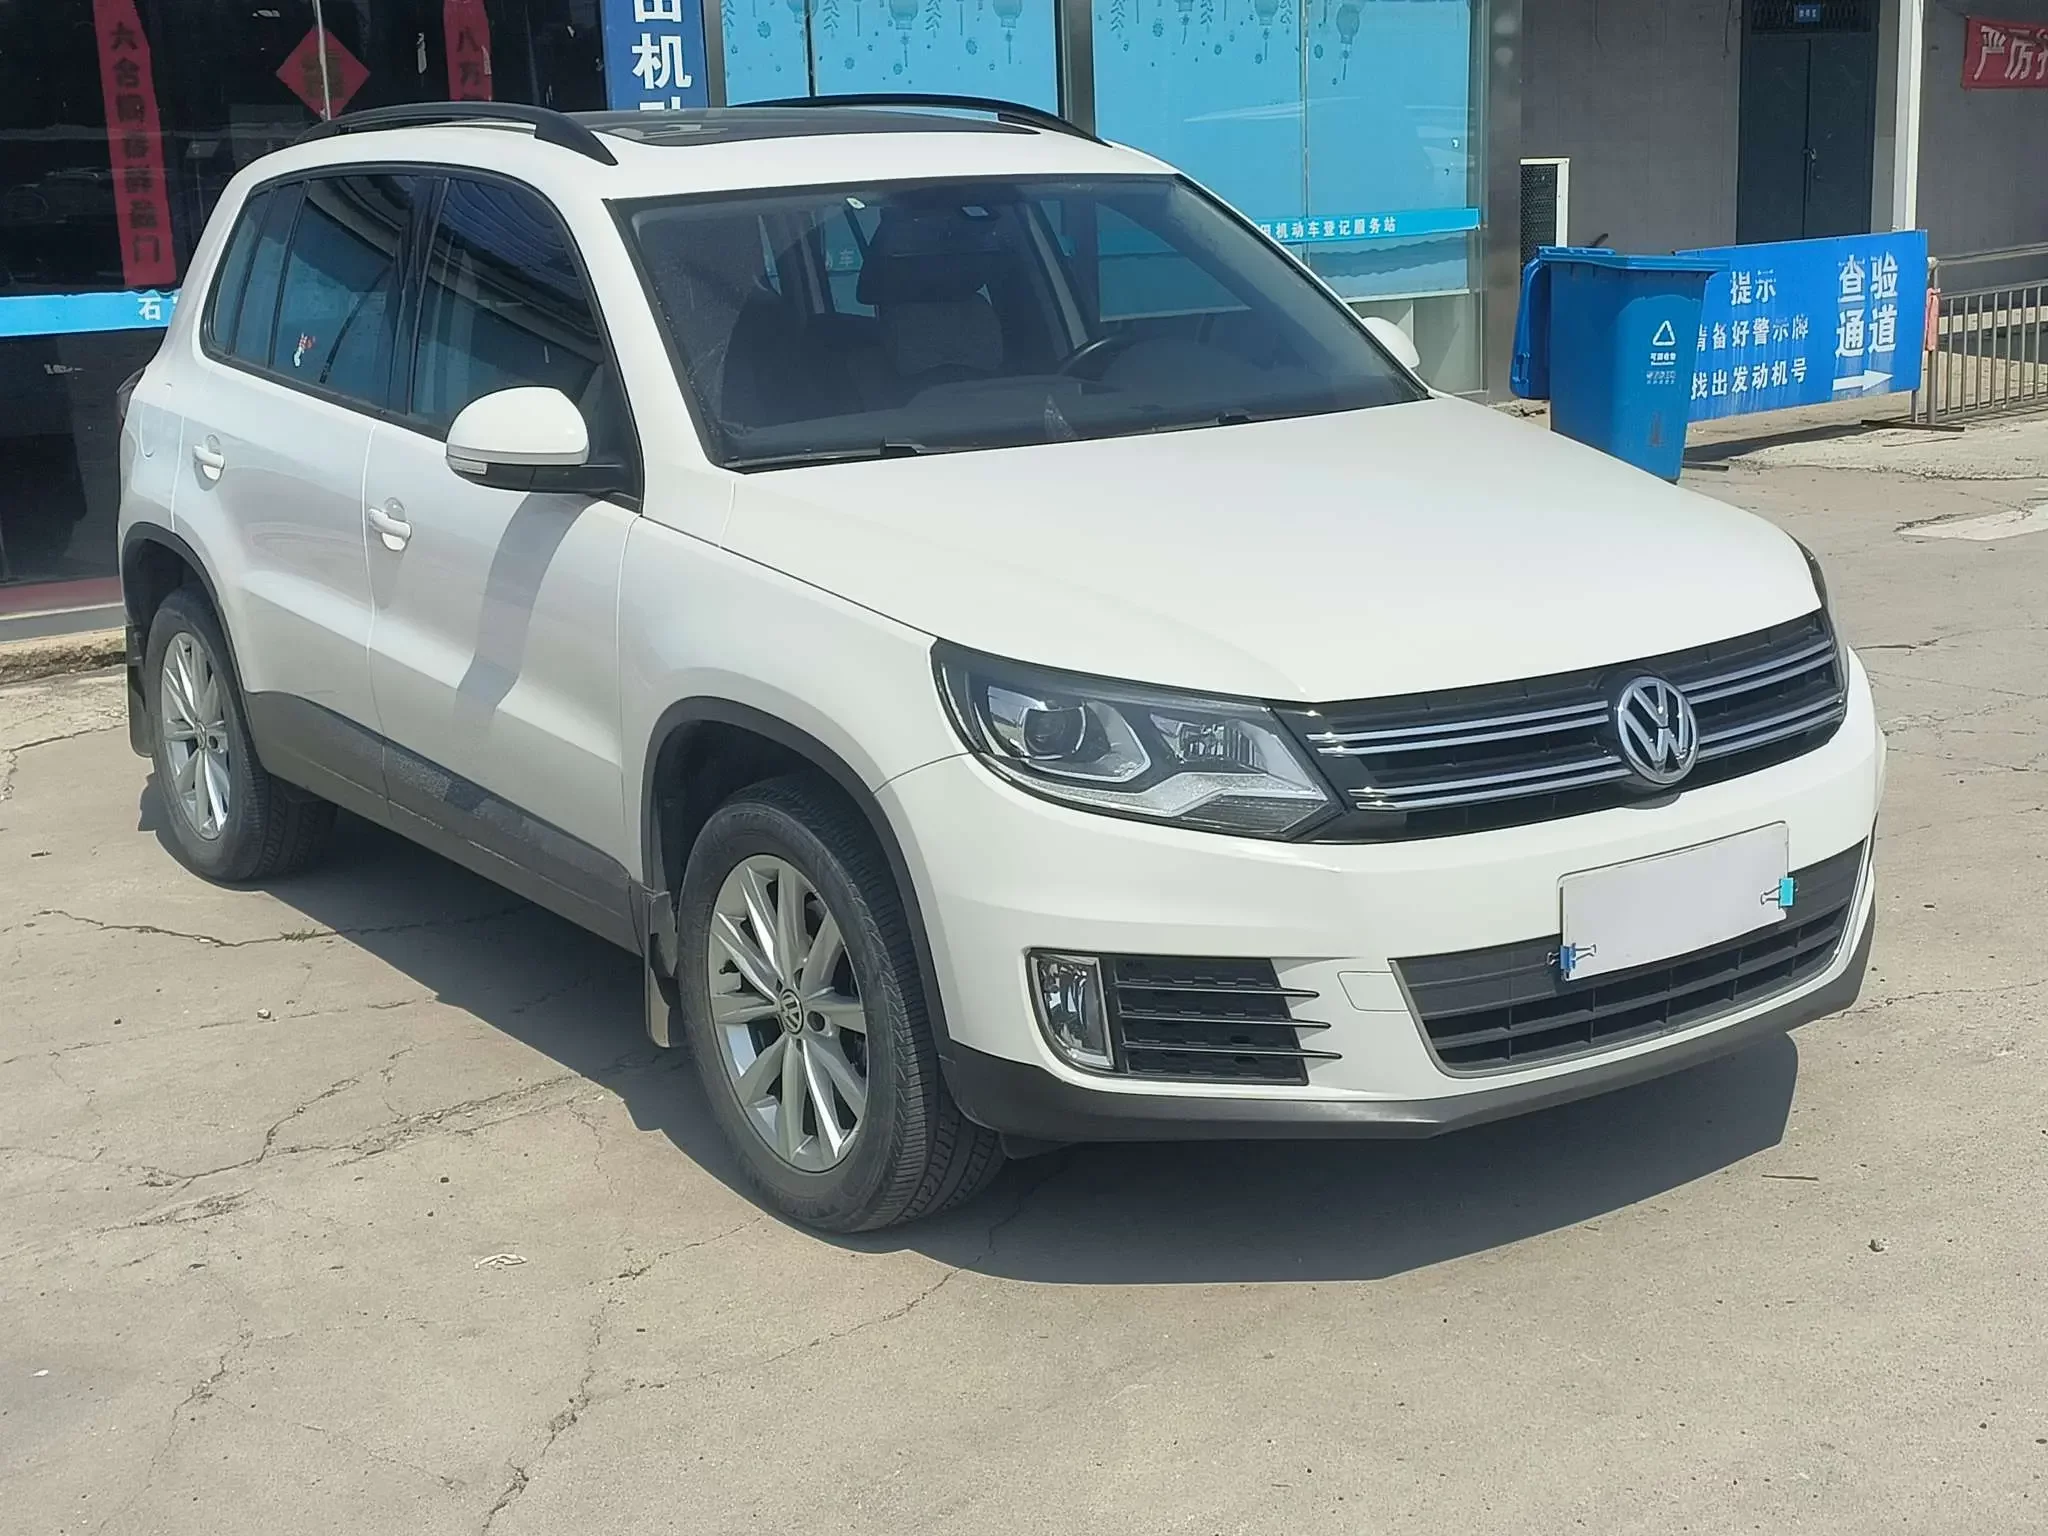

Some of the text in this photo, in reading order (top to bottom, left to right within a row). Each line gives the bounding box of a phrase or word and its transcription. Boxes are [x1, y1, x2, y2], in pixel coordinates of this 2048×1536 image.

[457, 27, 484, 100] 八方
[1974, 25, 2048, 80] 严厉
[1730, 268, 1777, 306] 提示
[1837, 251, 1898, 303] 查验
[137, 296, 178, 321] 石
[1835, 303, 1897, 358] 通道
[1691, 357, 1807, 400] 找出发动机号
